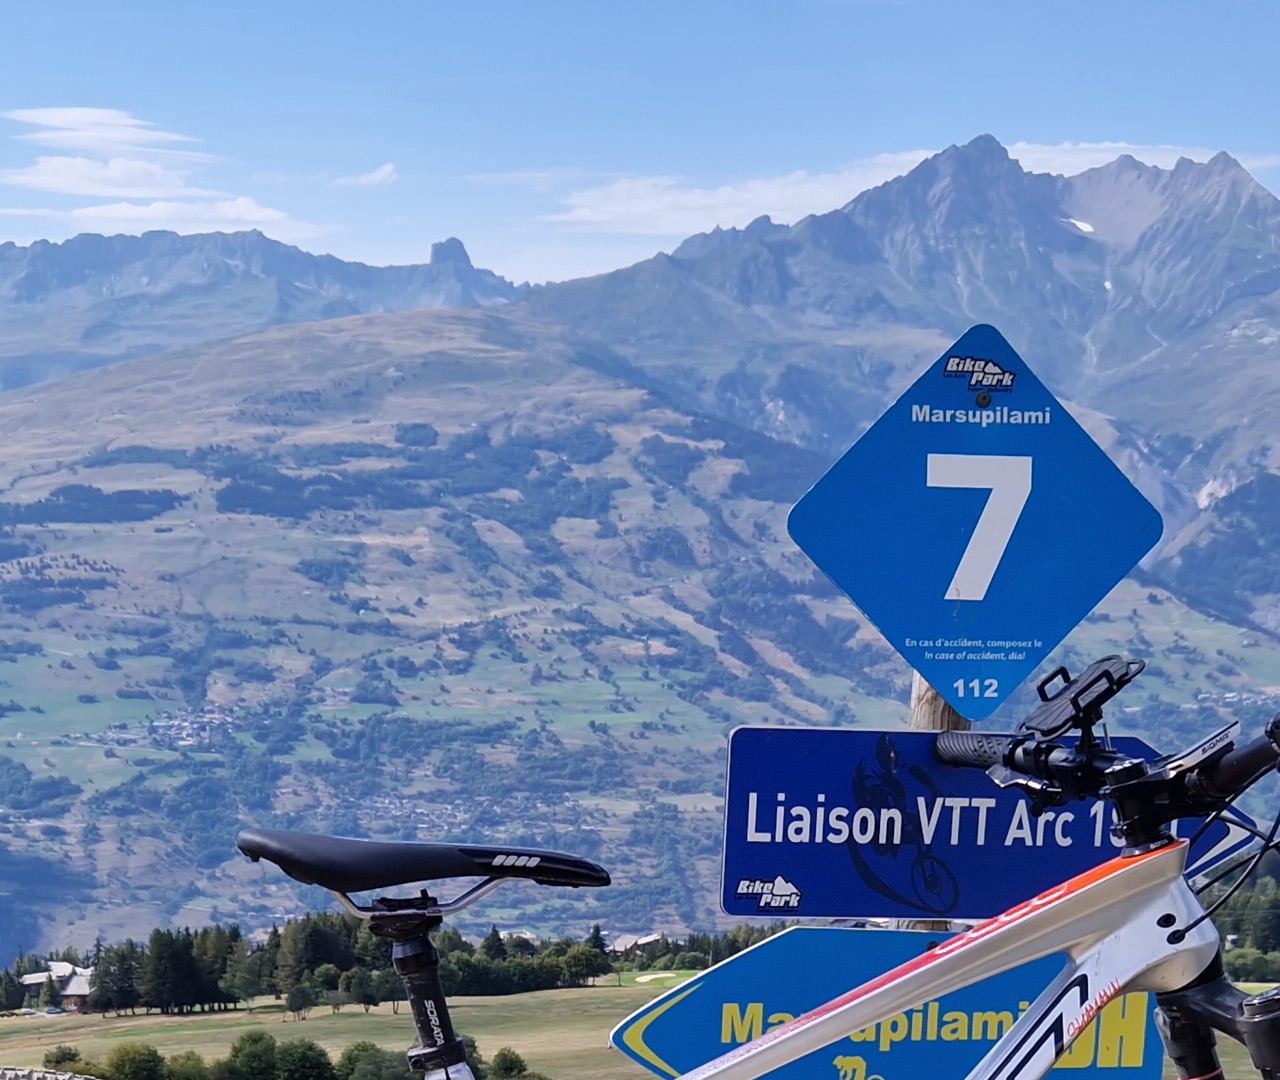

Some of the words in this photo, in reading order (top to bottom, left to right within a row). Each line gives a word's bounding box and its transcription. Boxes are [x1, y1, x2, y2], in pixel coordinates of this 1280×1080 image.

[946, 357, 986, 372] Bike
[970, 372, 1014, 386] Park
[912, 404, 1051, 428] Marsupilami
[926, 453, 1033, 601] 7
[905, 638, 917, 647] En
[986, 640, 1032, 649] composez
[1034, 639, 1042, 648] le
[924, 652, 933, 660] In
[956, 651, 966, 660] of
[1008, 651, 1026, 661] dial
[953, 679, 999, 698] 112
[746, 792, 902, 844] Liaison
[916, 797, 996, 846] VTT
[1004, 802, 1073, 847] Arc
[736, 880, 774, 894] Bike
[759, 894, 801, 907] Park
[424, 1000, 445, 1045] SORATA
[721, 1002, 1030, 1052] Mapilam
